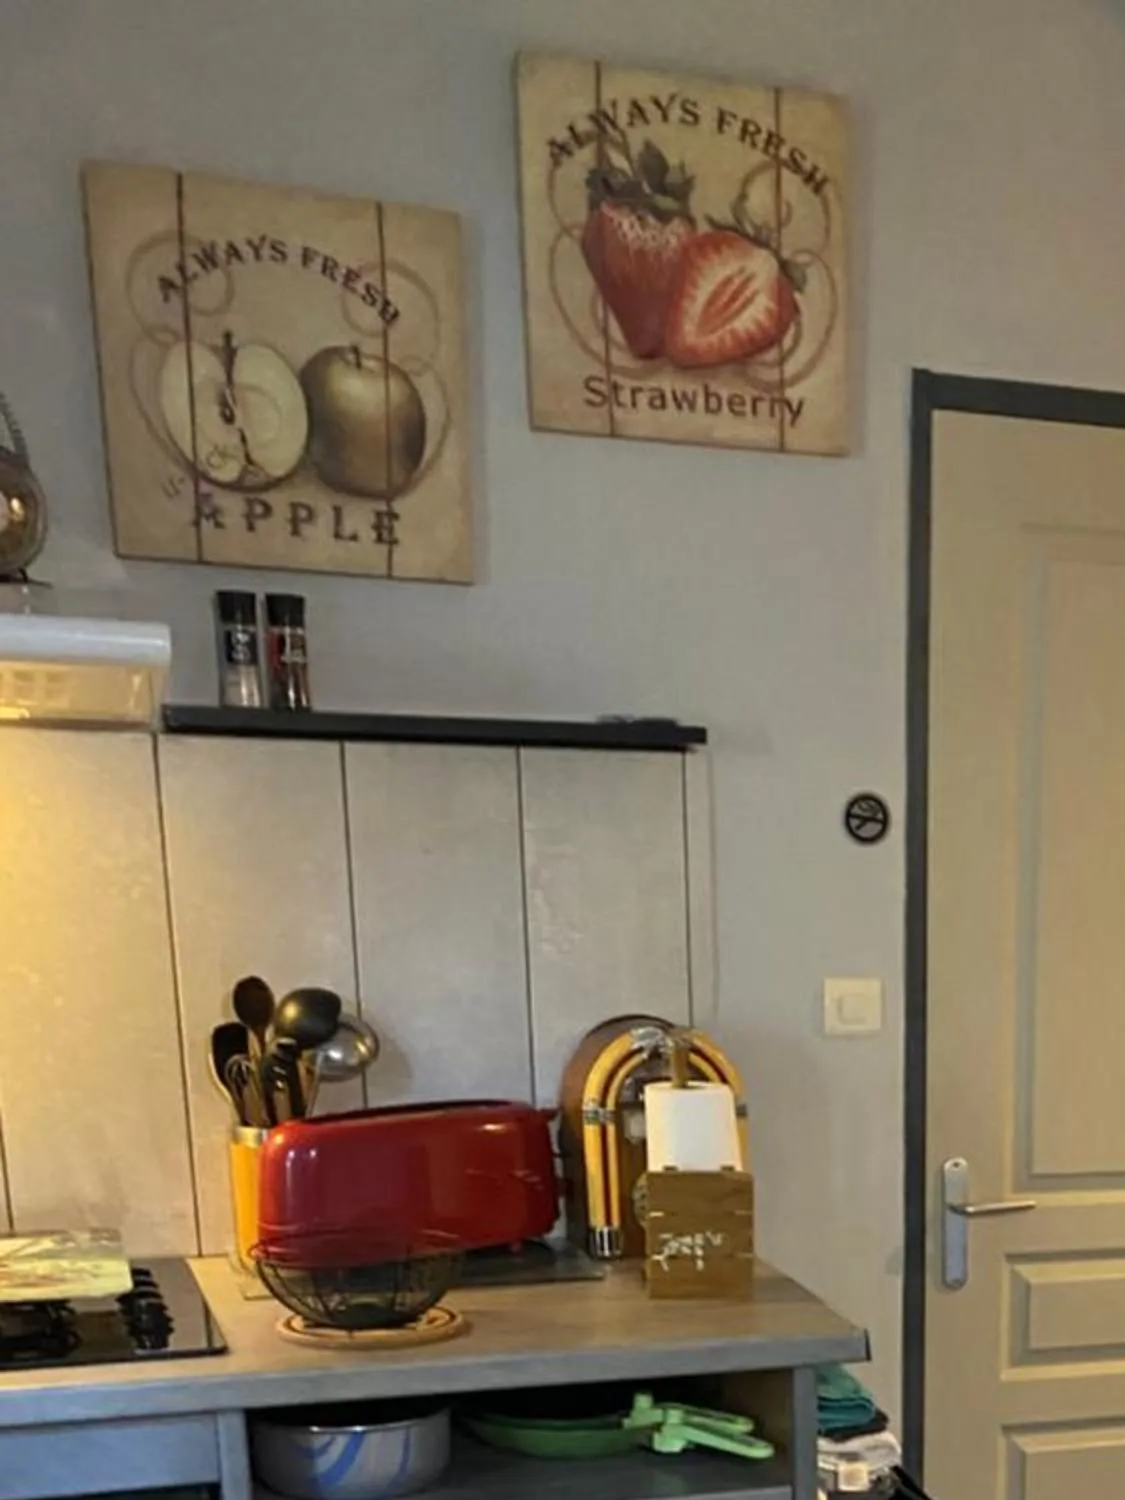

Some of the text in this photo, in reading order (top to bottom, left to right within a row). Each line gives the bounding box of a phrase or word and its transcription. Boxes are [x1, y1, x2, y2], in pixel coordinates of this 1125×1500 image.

[545, 92, 831, 195] ALWAYS FRESH
[157, 234, 400, 327] ALWAYS FRESH
[583, 375, 804, 428] Strawberry
[191, 492, 400, 545] APPLE
